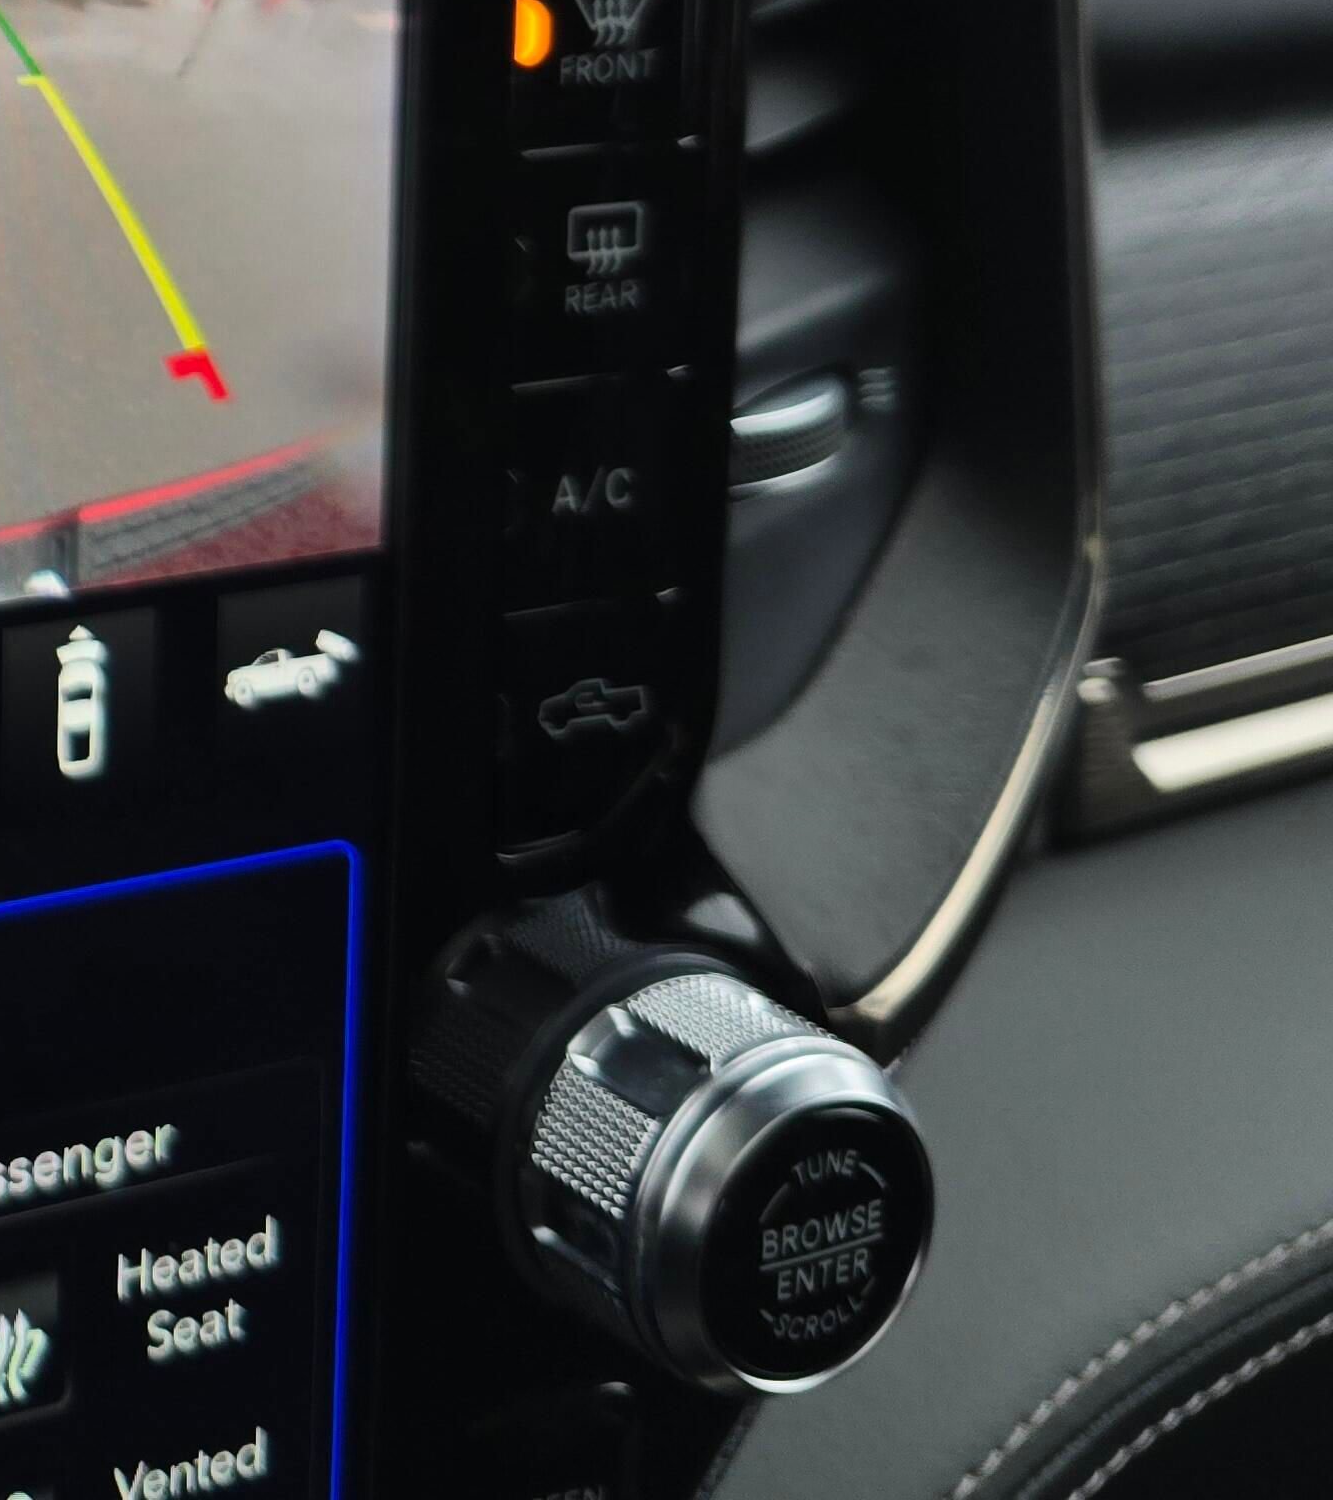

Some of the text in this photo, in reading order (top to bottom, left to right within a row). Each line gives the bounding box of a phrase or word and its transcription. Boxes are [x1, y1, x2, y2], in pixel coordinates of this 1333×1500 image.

[559, 47, 659, 86] FRONT
[564, 281, 639, 314] REAR
[551, 467, 634, 513] A/C
[791, 1148, 859, 1188] TUNE
[760, 1198, 883, 1257] BROWSE
[116, 1215, 281, 1301] Heated
[776, 1247, 870, 1300] ENTER
[145, 1297, 247, 1362] Seat
[771, 1294, 864, 1342] SCROLL
[113, 1425, 269, 1500] Vented
